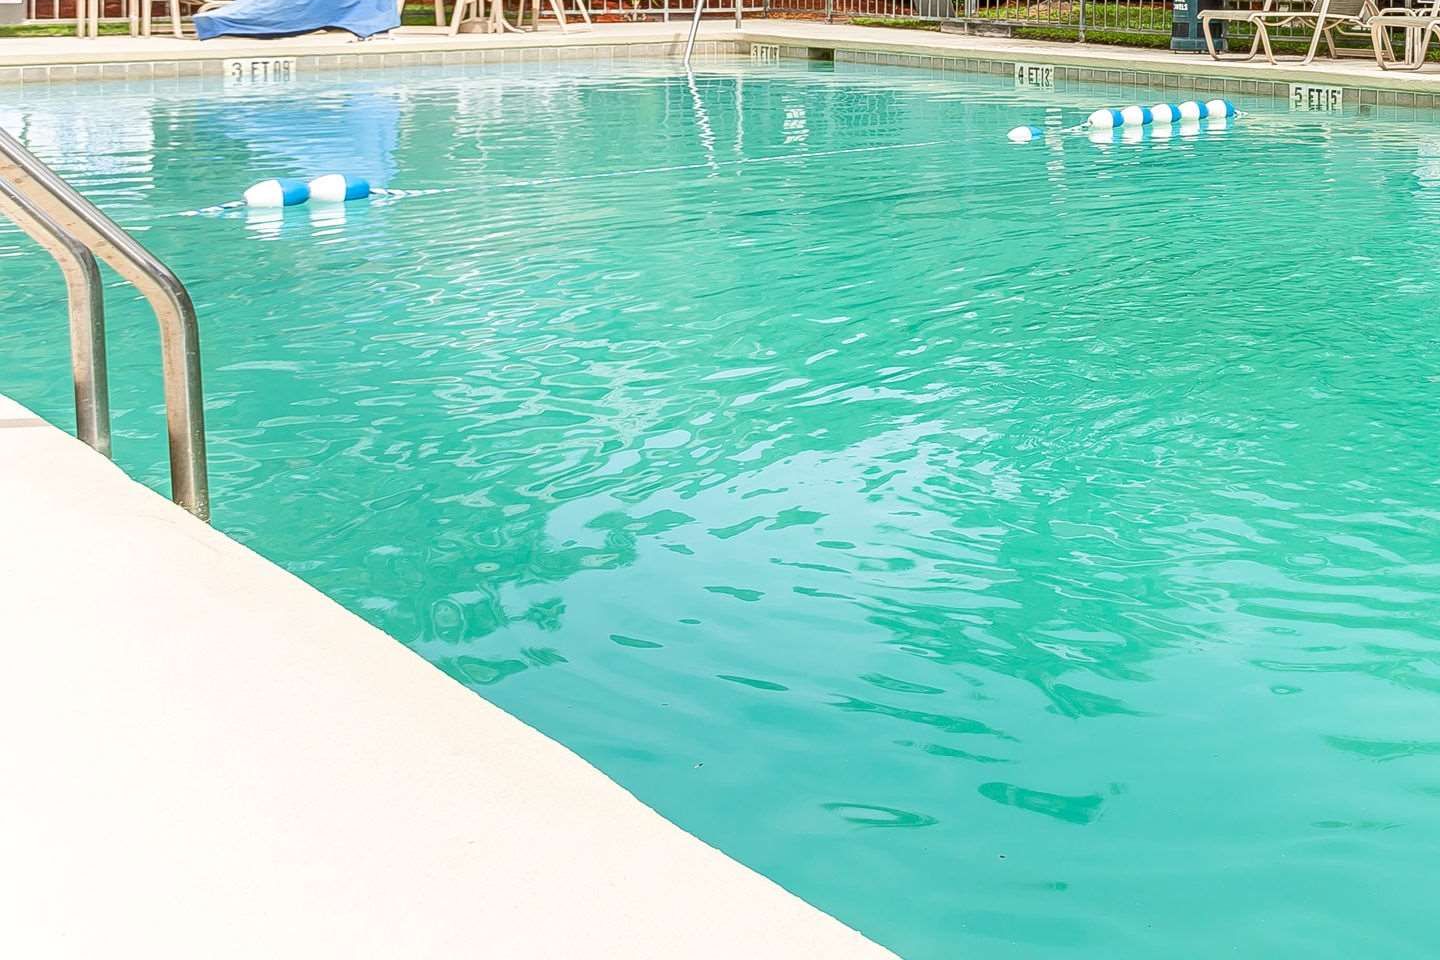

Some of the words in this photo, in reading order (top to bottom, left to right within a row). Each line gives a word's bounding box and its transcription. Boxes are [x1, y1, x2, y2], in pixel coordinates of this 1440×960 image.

[232, 62, 242, 81] 3
[251, 61, 270, 81] FT
[1295, 87, 1302, 104] 5
